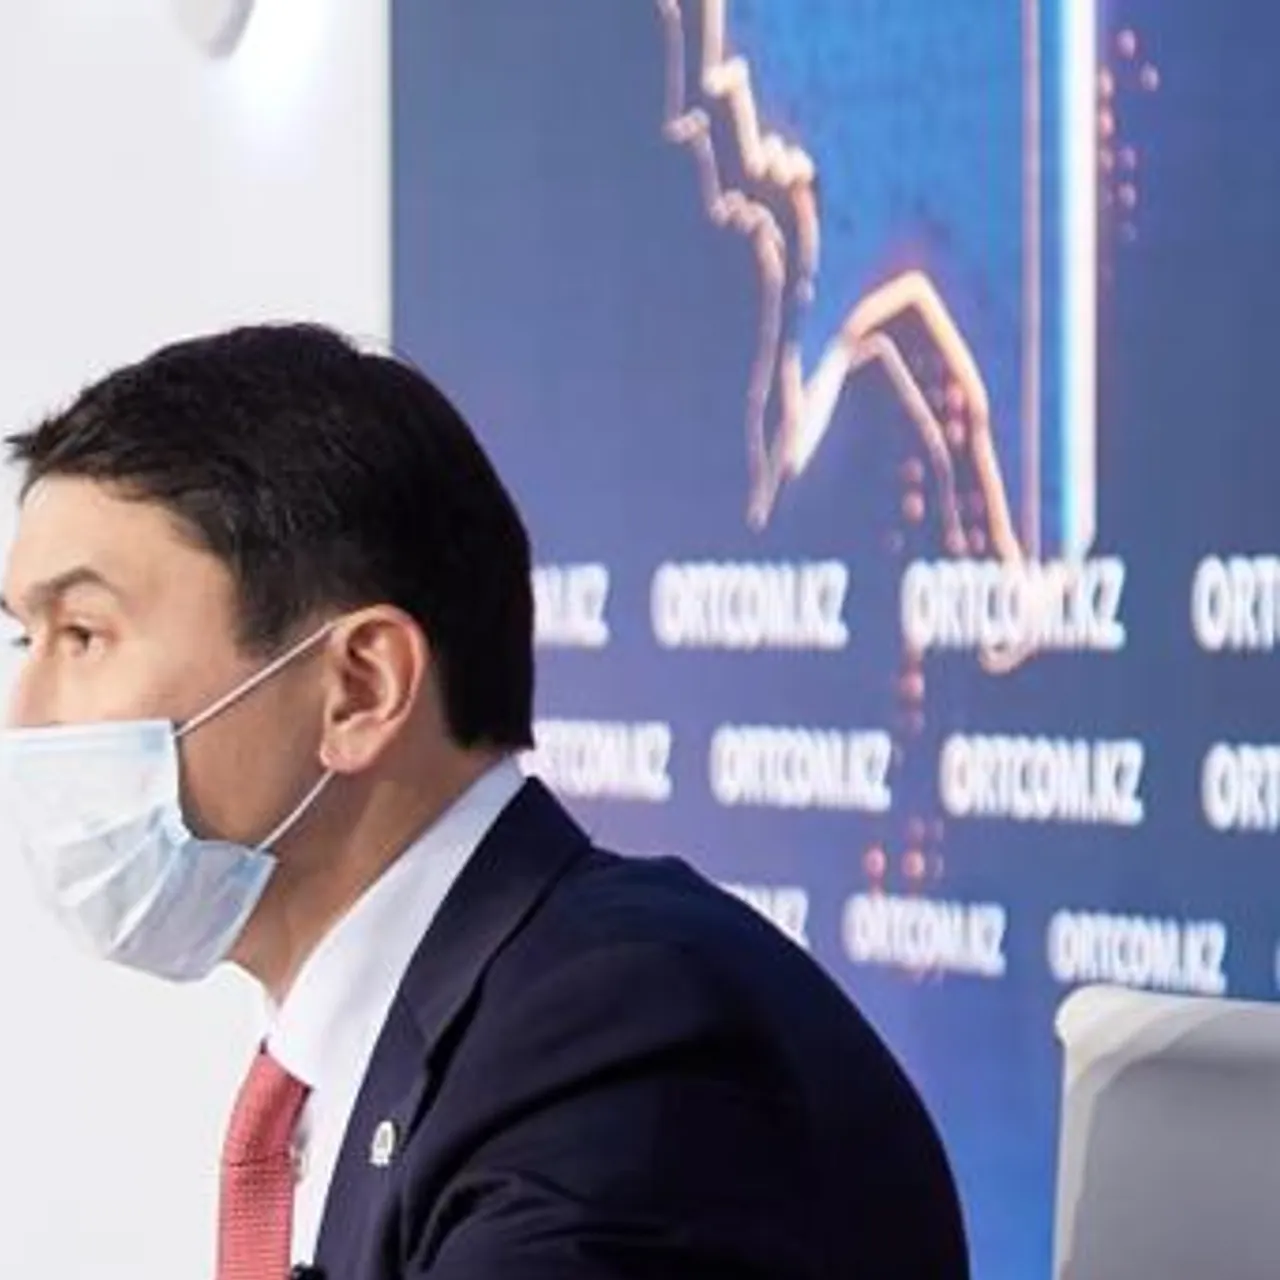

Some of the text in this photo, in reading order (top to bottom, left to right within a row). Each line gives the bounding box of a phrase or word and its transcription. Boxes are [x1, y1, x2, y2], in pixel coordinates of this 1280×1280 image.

[650, 559, 849, 649] ORTCOM.KZ
[901, 555, 1125, 650] ORTCOM.KZ
[710, 722, 891, 811] ORTCOM.KZ
[940, 731, 1142, 824] ORTCOM.KZ
[843, 893, 1006, 976] ORTCOM.KZ
[1048, 908, 1227, 992] ORTCOM.KZ
